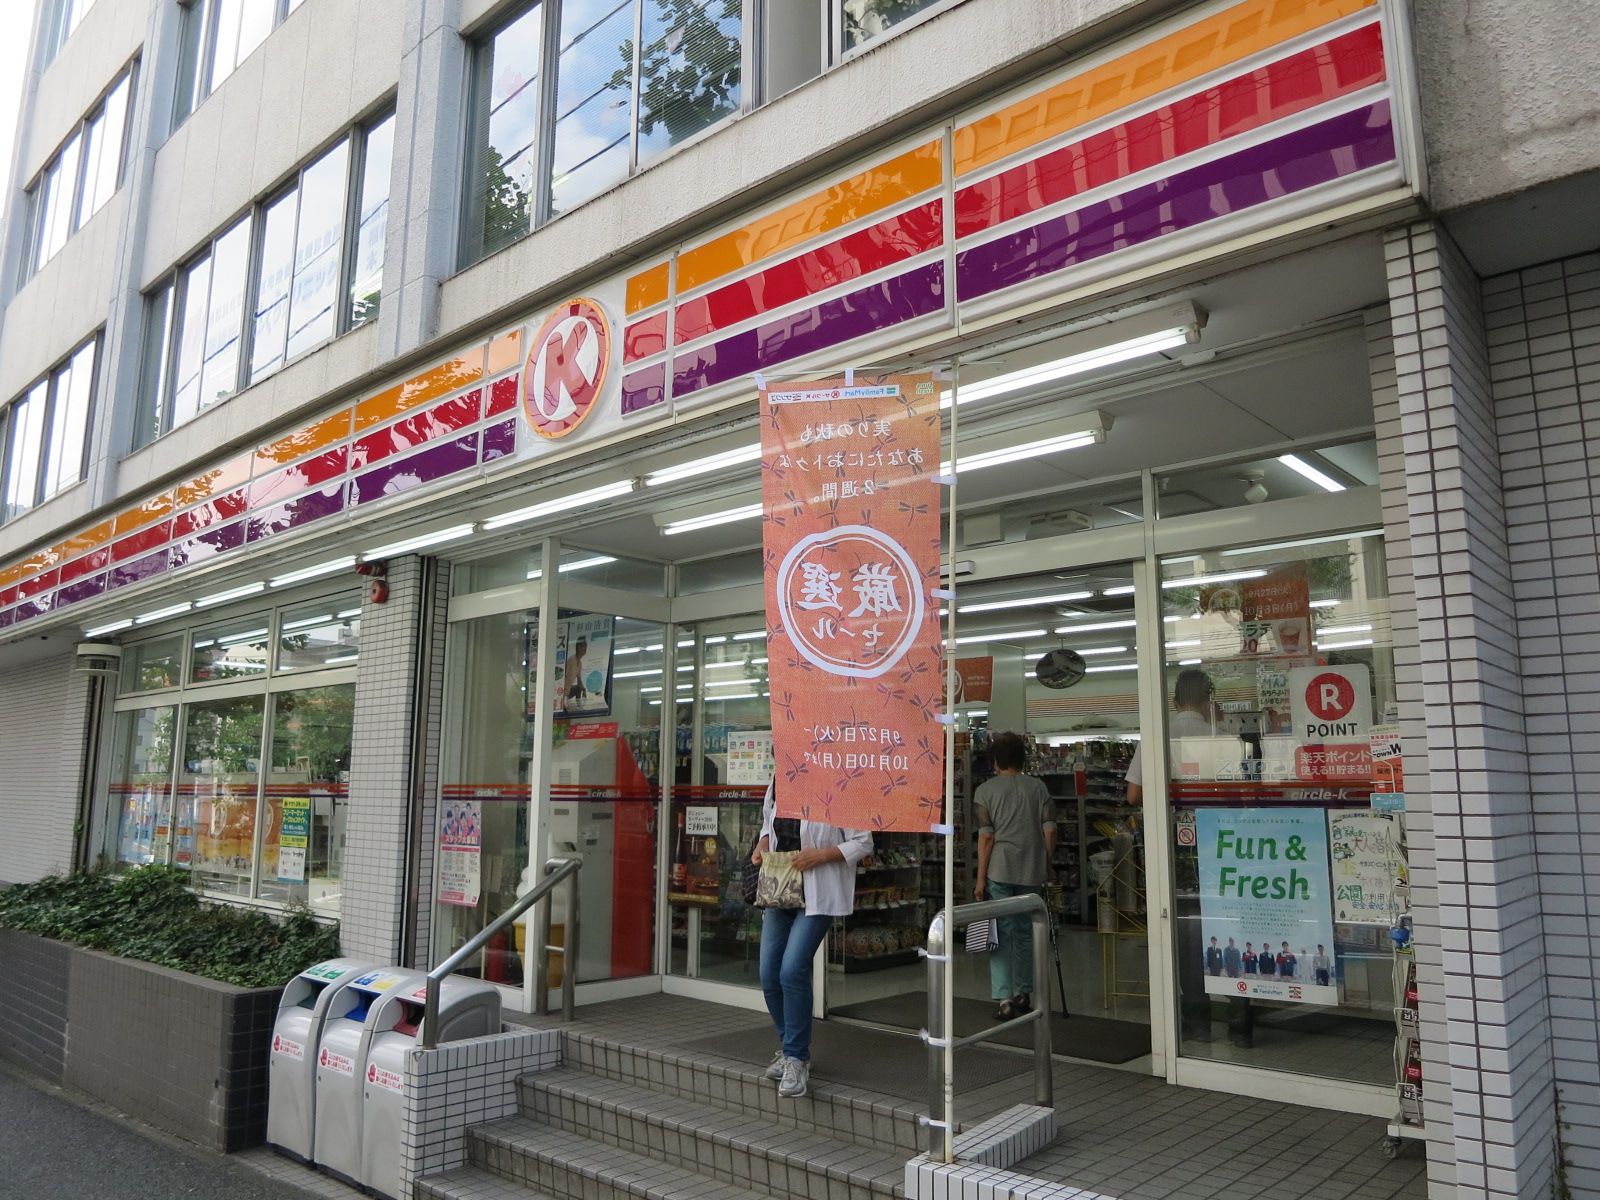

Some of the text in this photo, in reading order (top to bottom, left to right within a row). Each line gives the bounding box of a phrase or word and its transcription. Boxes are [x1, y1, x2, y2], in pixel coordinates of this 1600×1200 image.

[533, 315, 599, 420] K
[1320, 684, 1341, 711] R
[1306, 722, 1358, 738] POINT
[1300, 750, 1370, 764] 楽天ポイント
[1291, 789, 1348, 800] circle-k
[1216, 829, 1307, 861] Fun &
[1219, 866, 1311, 900] Fresh
